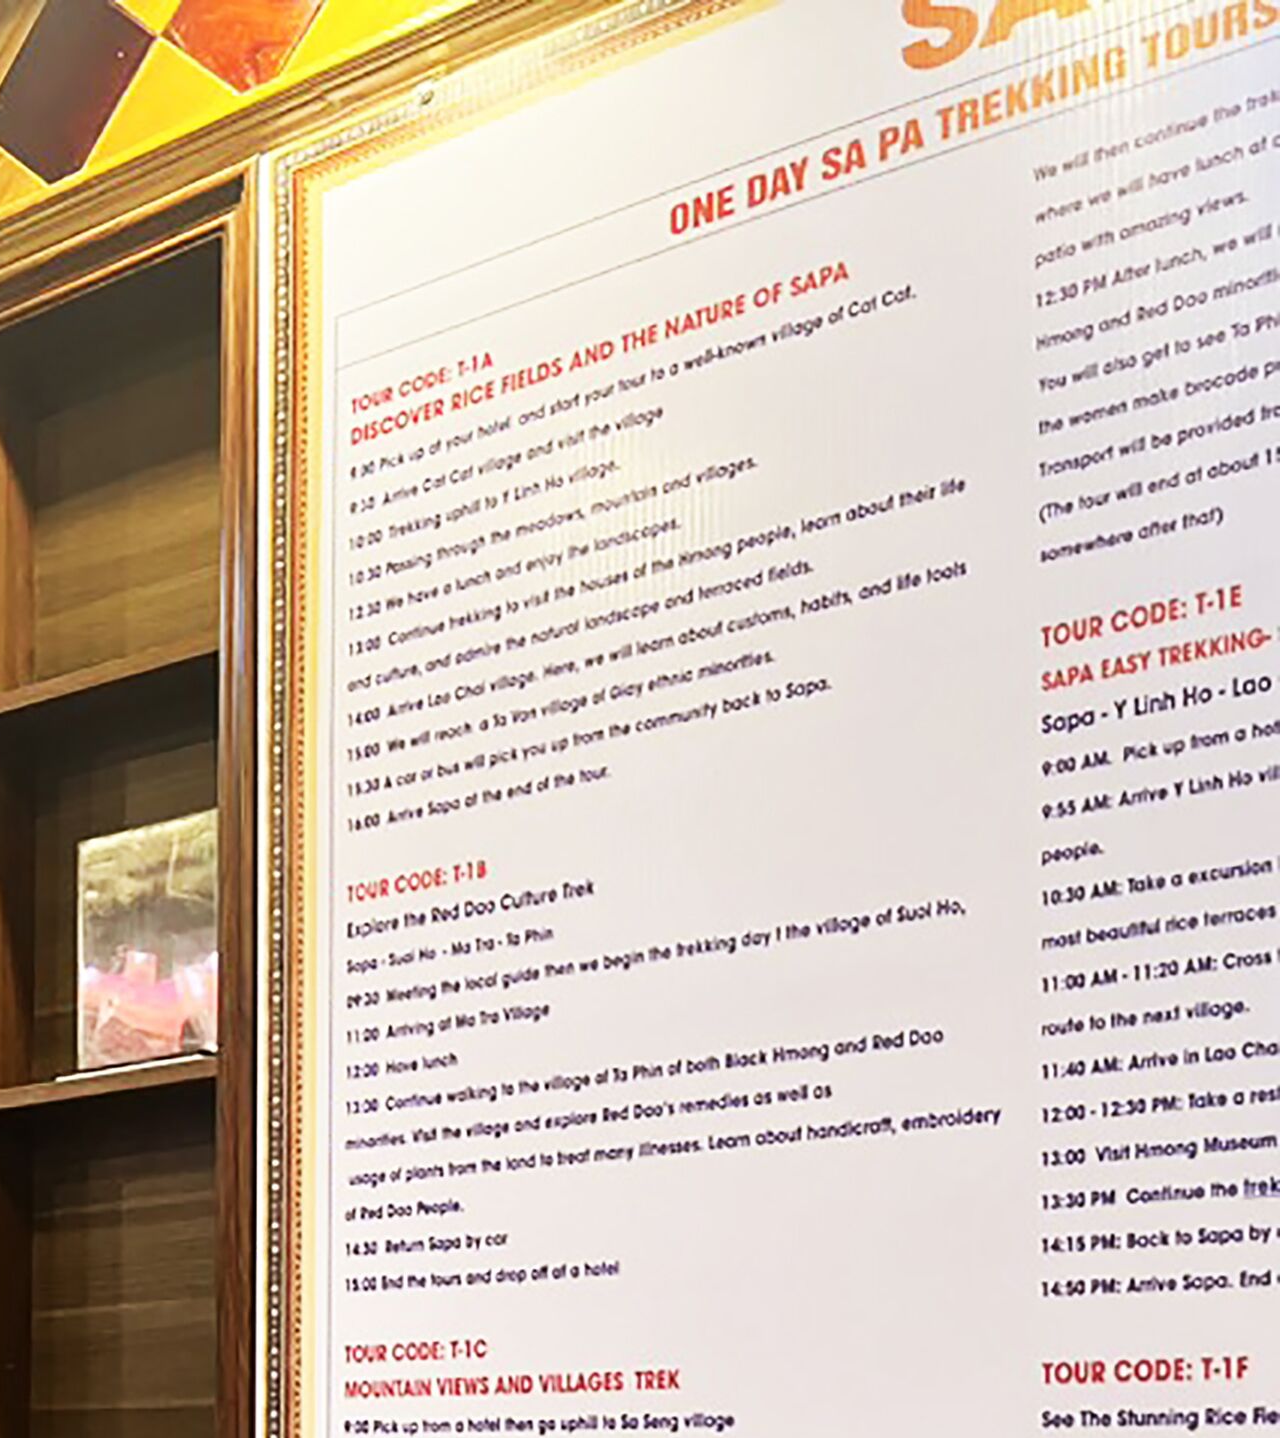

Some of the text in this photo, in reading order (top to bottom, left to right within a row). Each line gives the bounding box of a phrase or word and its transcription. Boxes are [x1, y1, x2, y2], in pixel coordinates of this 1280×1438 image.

[669, 0, 1280, 235] ONE DAY SA PA TREKKING TOURS
[351, 262, 849, 445] DISCOVER RICE FIELDS AND THE NATURE OF SAPA
[352, 387, 393, 413] TOUR
[458, 352, 493, 376] T-1A
[1041, 507, 1224, 563] somewhere after that)
[1041, 584, 1242, 648] TOUR CODE: T-1E
[1041, 663, 1094, 692] SAPA
[1101, 650, 1151, 680] EASY
[1042, 710, 1095, 734] Sapa
[1114, 699, 1127, 720] Y
[1134, 691, 1176, 716] Linh
[1182, 685, 1213, 708] Ho
[1232, 676, 1272, 698] Lao
[1041, 841, 1104, 866] people.
[347, 860, 487, 903] TOUR CODE: T-1B
[1041, 1001, 1250, 1036] route to the next village.
[345, 1339, 487, 1364] TOUR CODE: T-1C
[1042, 1356, 1248, 1385] TOUR CODE: T-1F
[344, 1369, 680, 1399] MOUNTAIN VIEWS AND VILLAGES TREK
[1042, 1410, 1075, 1429] See
[1080, 1410, 1112, 1428] The
[1117, 1408, 1199, 1432] Stunning
[1205, 1408, 1247, 1426] Rice
